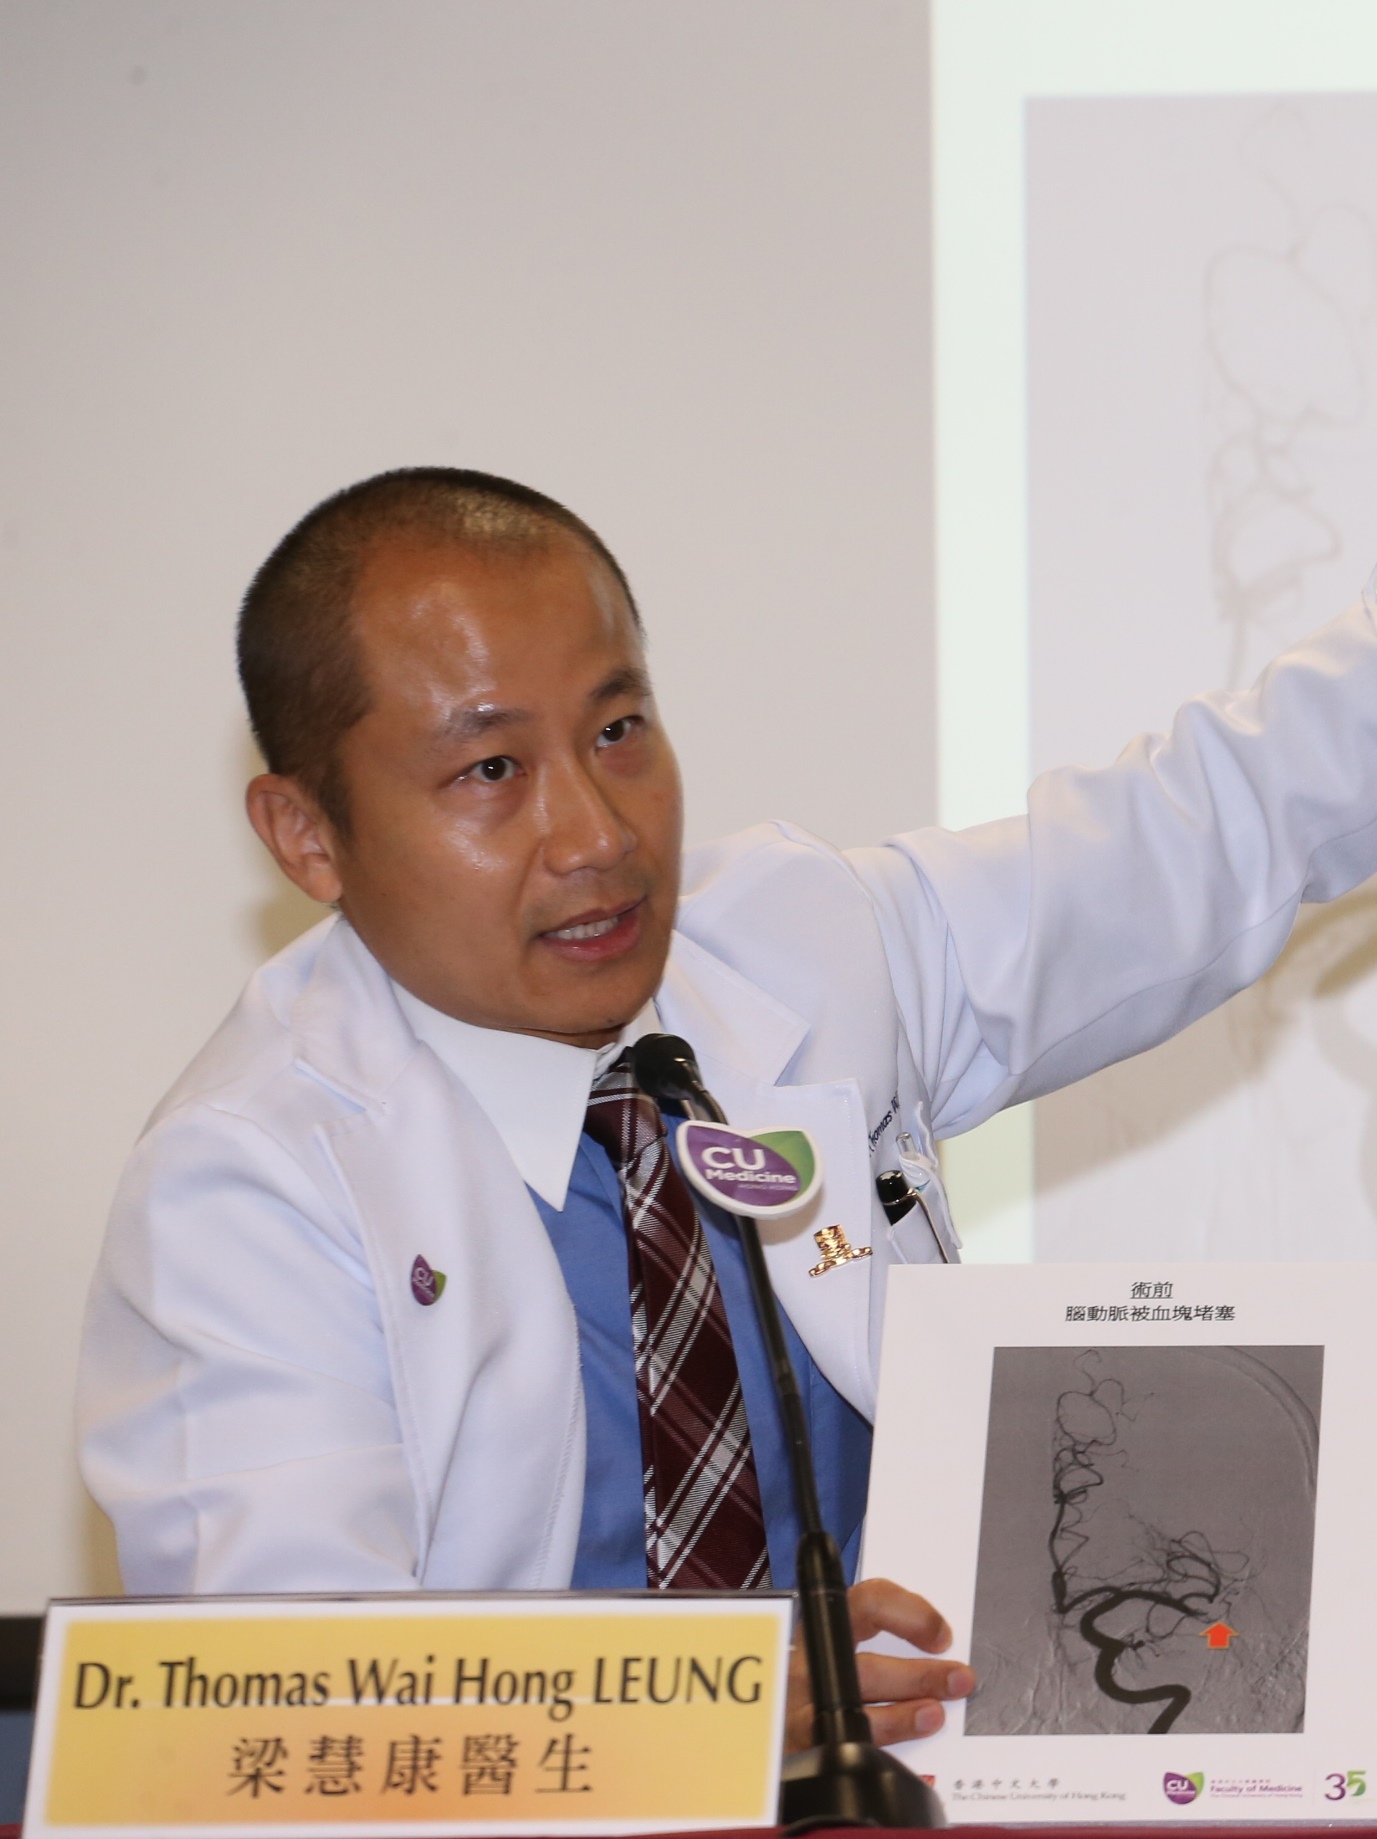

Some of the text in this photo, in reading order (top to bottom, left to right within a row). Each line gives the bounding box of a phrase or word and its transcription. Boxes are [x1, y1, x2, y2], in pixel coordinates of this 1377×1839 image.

[701, 1146, 766, 1171] CU
[705, 1168, 797, 1184] Medicine
[1130, 1281, 1174, 1299] 術前
[1065, 1305, 1236, 1322] 腦動脈被血塊堵塞
[74, 1654, 763, 1720] Dr. Thomas Wai Hong LEUNG
[227, 1734, 595, 1798] 梁慧康醫生
[1166, 1779, 1189, 1792] CU
[1210, 1785, 1243, 1793] Faculty
[1324, 1770, 1367, 1801] 35
